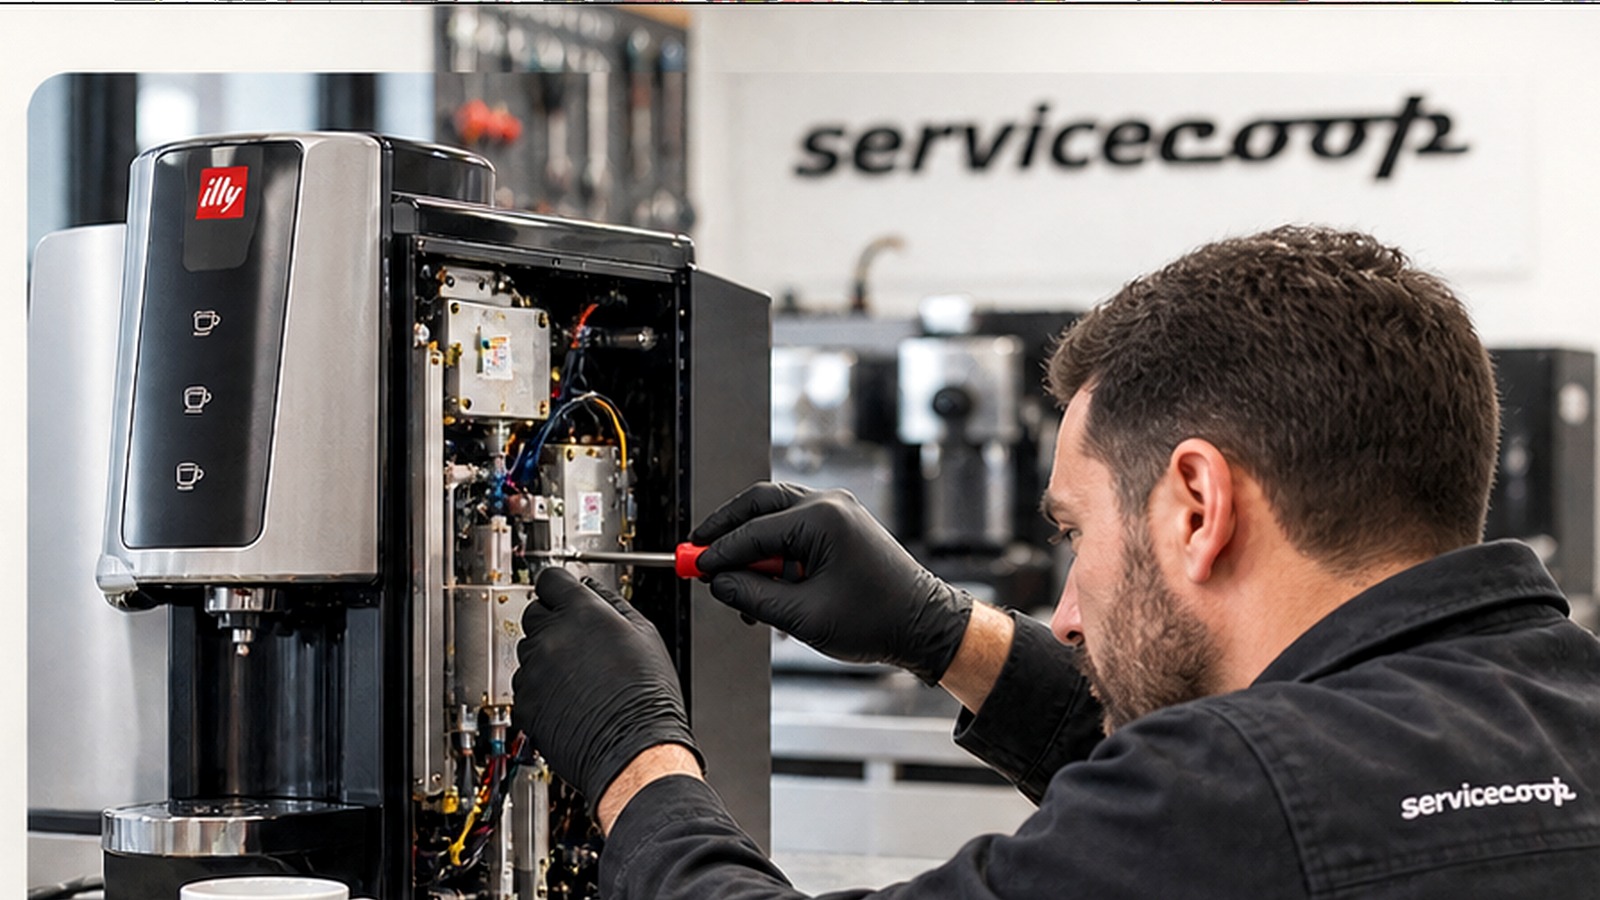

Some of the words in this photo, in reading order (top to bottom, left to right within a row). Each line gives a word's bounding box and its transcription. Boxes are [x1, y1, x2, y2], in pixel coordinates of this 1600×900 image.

[795, 93, 1470, 180] servicecoop
[200, 176, 243, 214] illy
[1401, 776, 1576, 819] servicecoop
